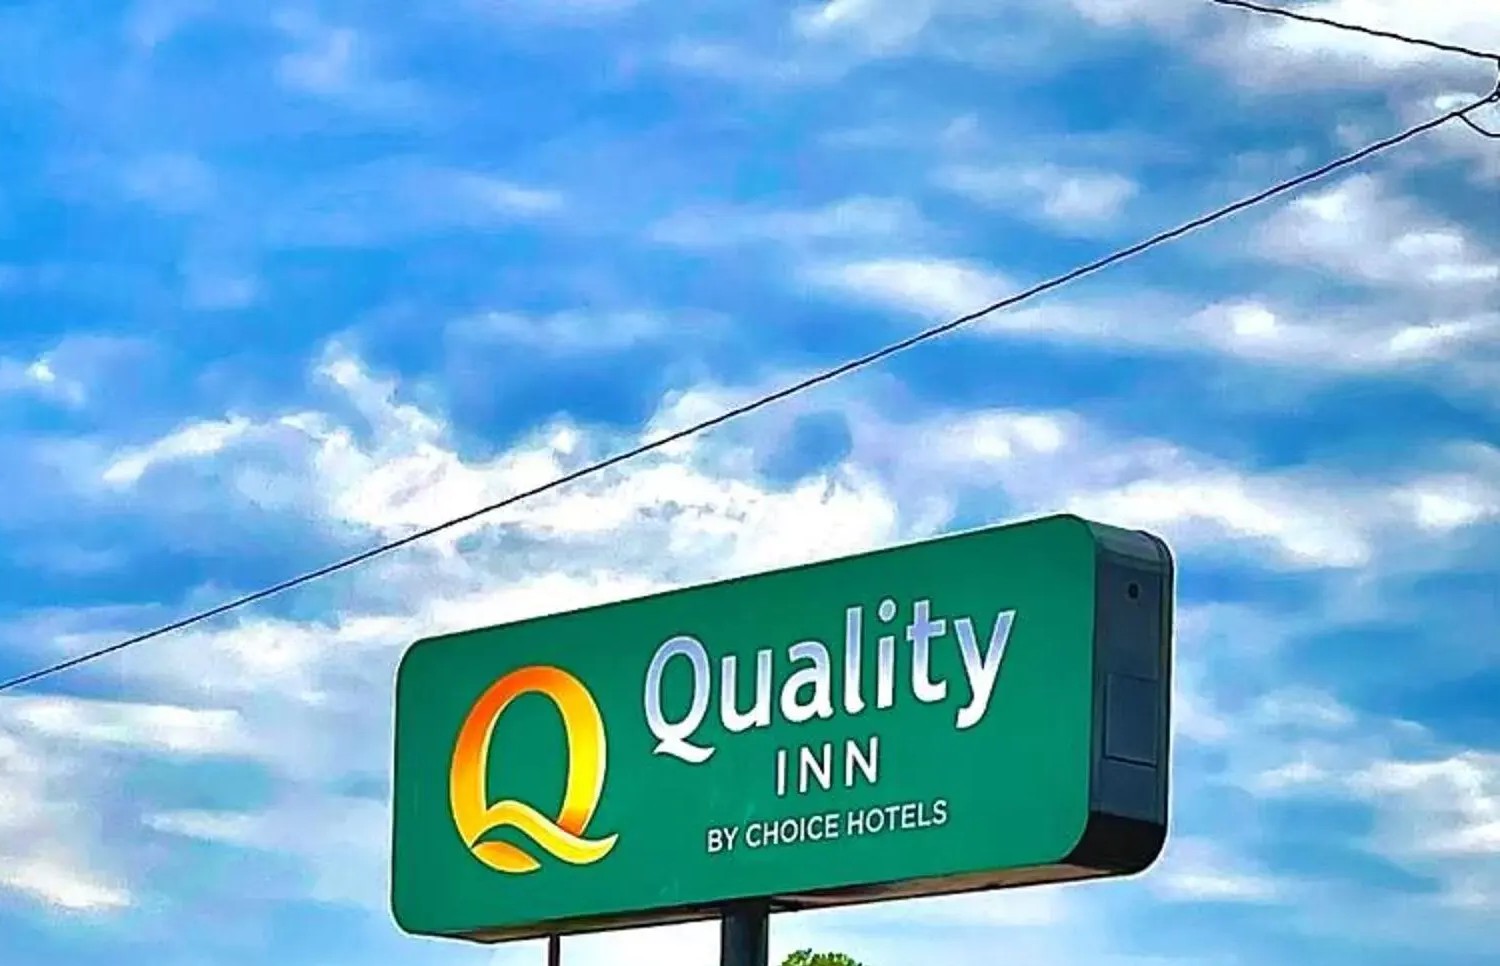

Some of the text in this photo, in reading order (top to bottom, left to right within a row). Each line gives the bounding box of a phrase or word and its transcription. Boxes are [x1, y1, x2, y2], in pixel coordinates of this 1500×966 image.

[644, 598, 1016, 763] Quality
[449, 664, 620, 873] Q
[775, 736, 879, 796] INN
[708, 800, 947, 852] BY CHOICE HOTELS
